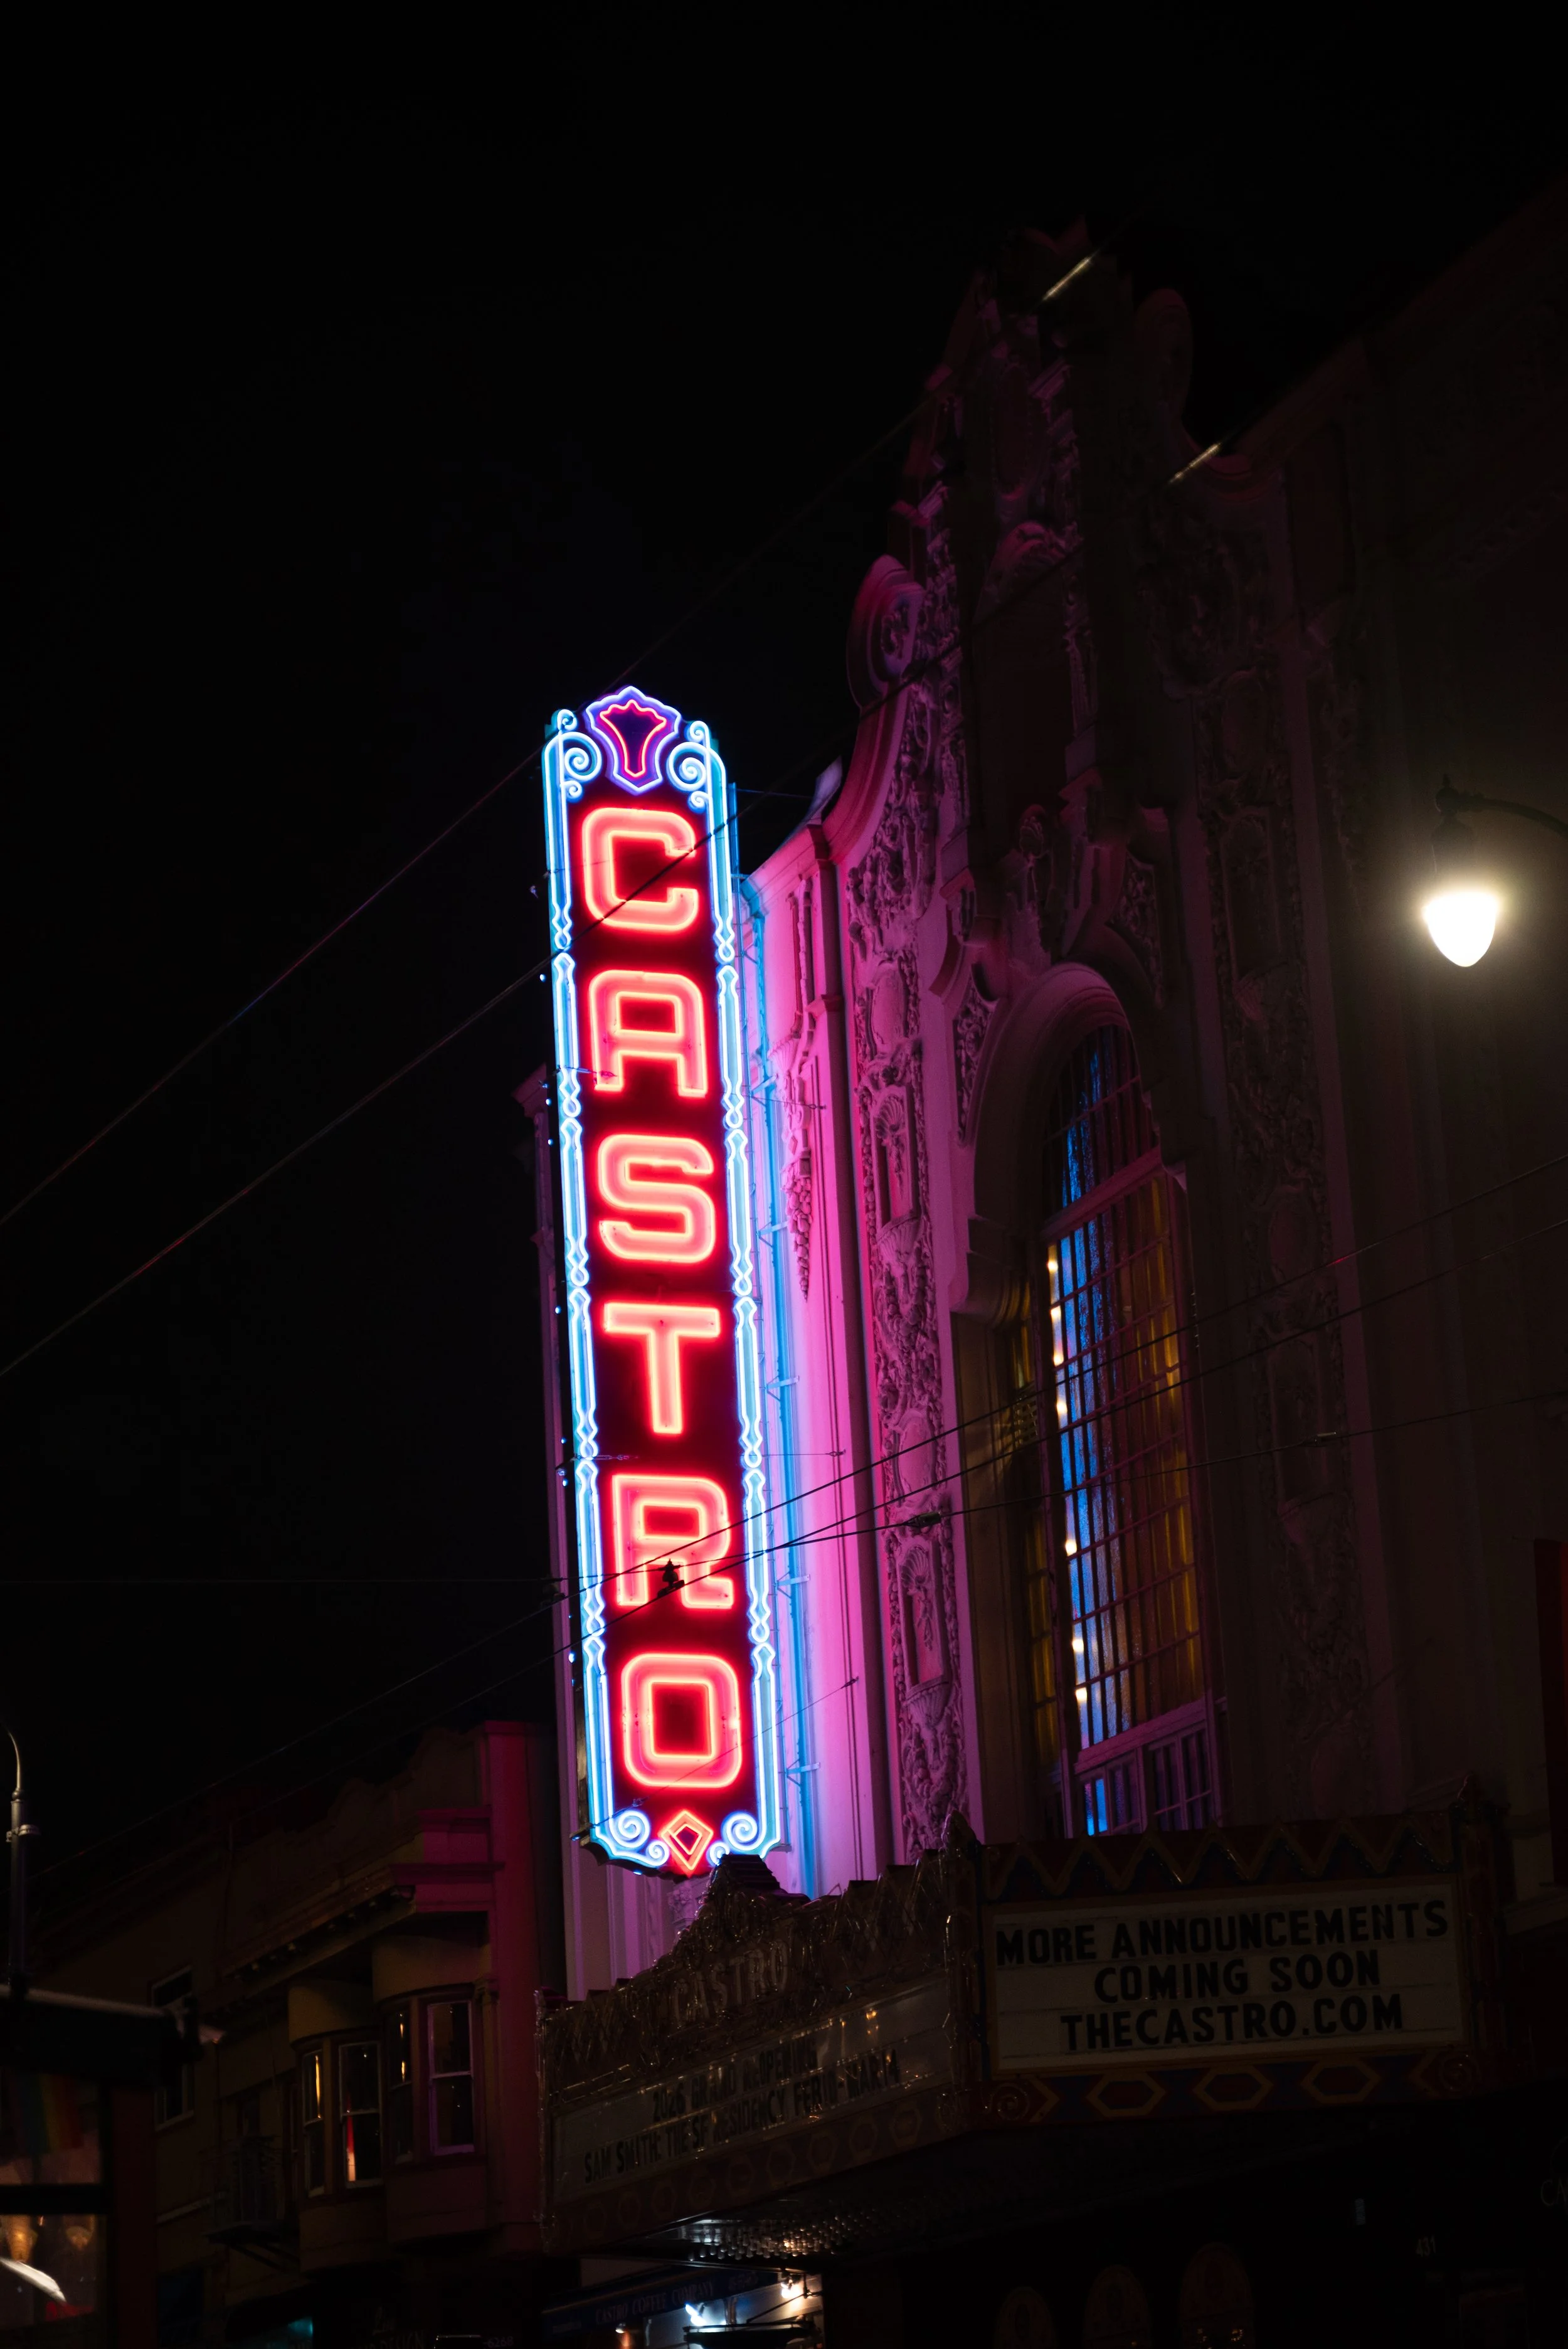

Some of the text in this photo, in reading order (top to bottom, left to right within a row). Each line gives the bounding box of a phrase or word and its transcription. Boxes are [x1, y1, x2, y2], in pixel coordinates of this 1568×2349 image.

[578, 804, 744, 1791] CASTRO
[995, 1900, 1449, 1966] MORE ANNOUNCEMENTS
[672, 1938, 790, 2026] CASTRO
[1094, 1949, 1380, 2003] COMING SOON
[1060, 1993, 1403, 2052] THECASTRO.COM
[653, 2082, 686, 2123] 2026
[691, 2060, 736, 2109] GRAND
[585, 2148, 611, 2184] SAM
[617, 2133, 662, 2175] SMITH:
[665, 2121, 689, 2158] THE
[713, 2088, 786, 2143] RESIDENCY
[1415, 2234, 1437, 2257] 431
[595, 2303, 629, 2325] CASTRO
[632, 2293, 667, 2315] COFFEE
[671, 2279, 715, 2306] COMPANY
